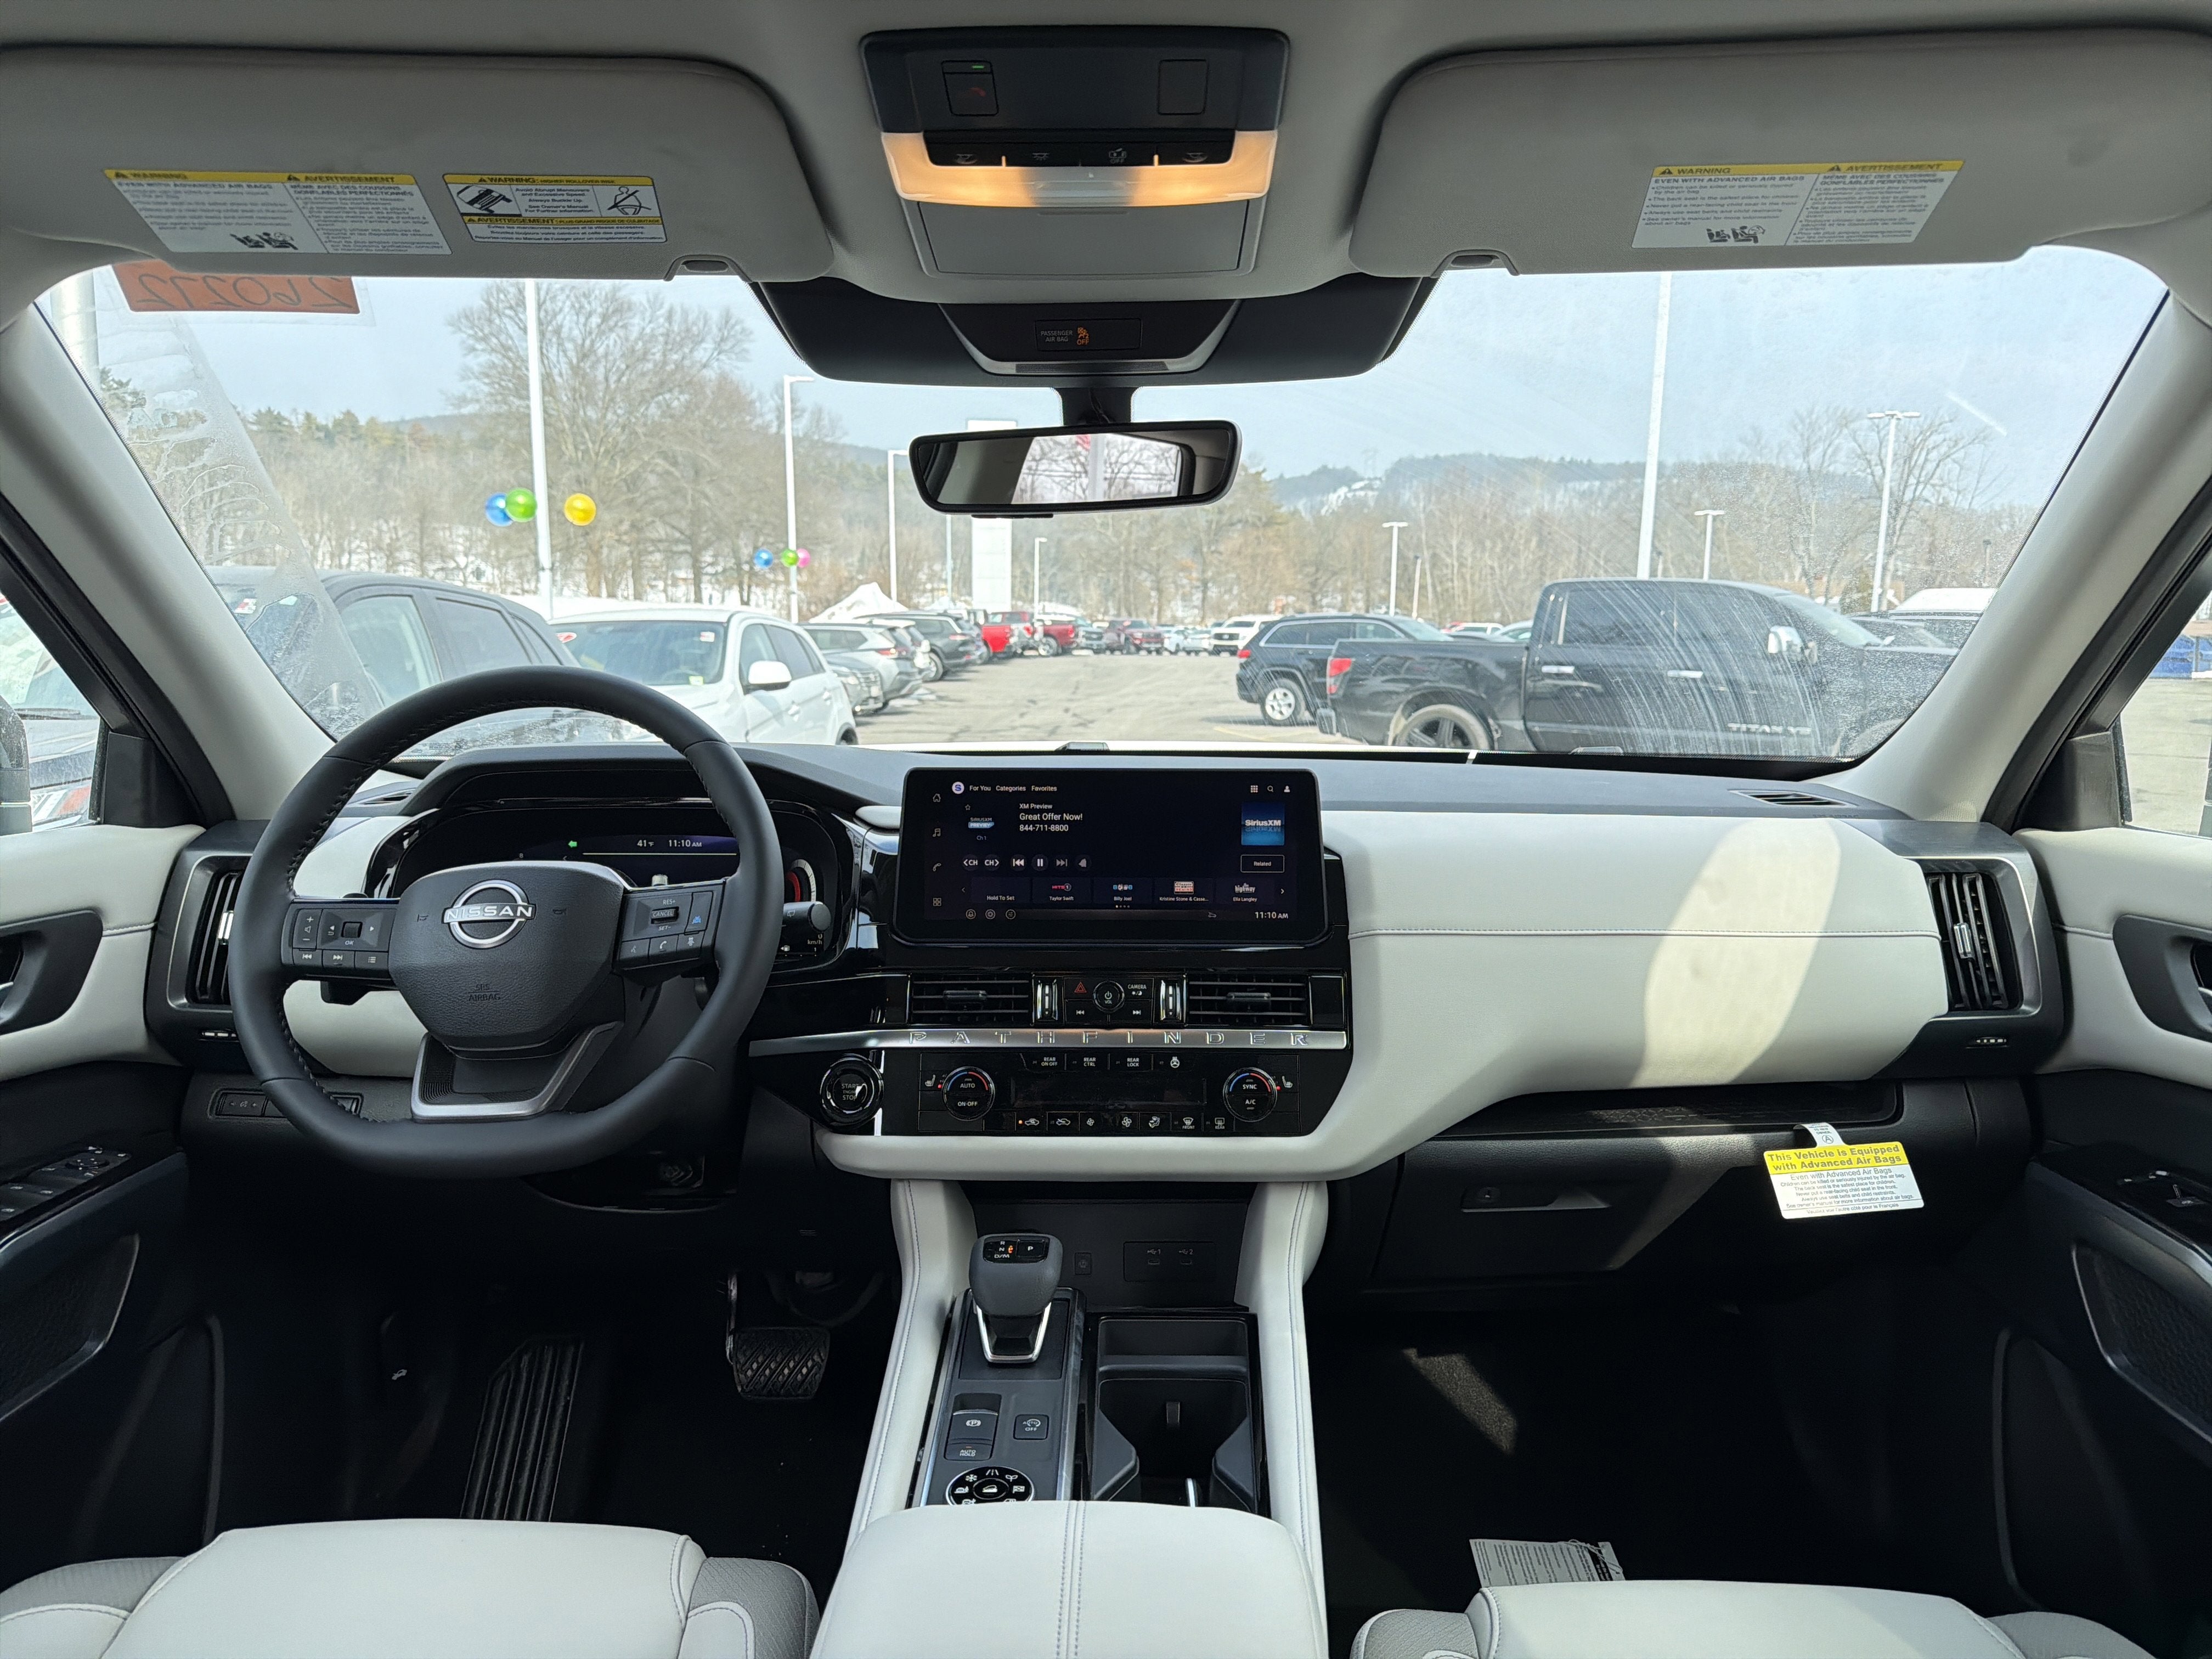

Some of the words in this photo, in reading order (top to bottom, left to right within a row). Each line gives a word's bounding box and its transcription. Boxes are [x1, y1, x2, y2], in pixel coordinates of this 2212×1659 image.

[1727, 723, 1783, 733] TITAN
[447, 906, 532, 921] NISSAN
[909, 1031, 1308, 1045] PATHFINDER
[1768, 1154, 1792, 1162] This
[1794, 1150, 1835, 1160] Vehicle
[1849, 1145, 1900, 1156] Equipped
[1773, 1163, 1797, 1171] with
[1801, 1158, 1853, 1170] Advanced
[1874, 1155, 1901, 1164] Bags
[1826, 1170, 1861, 1178] Advanced
